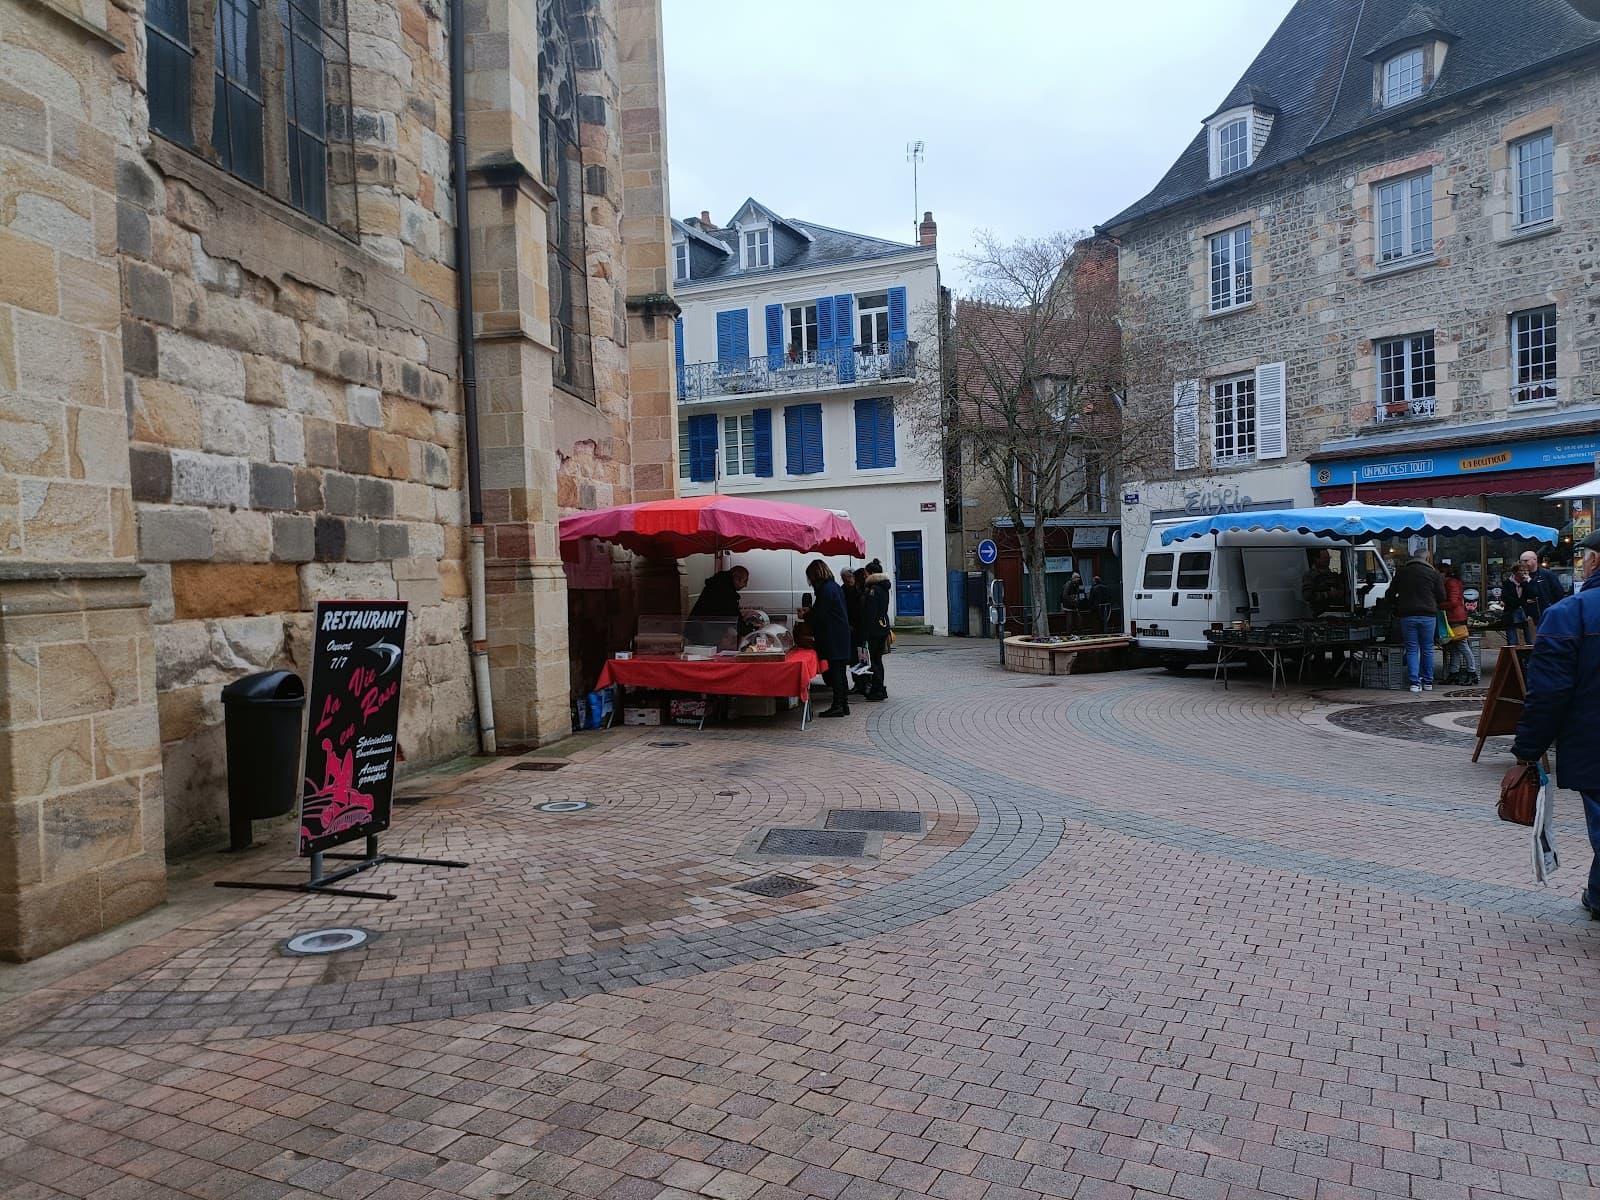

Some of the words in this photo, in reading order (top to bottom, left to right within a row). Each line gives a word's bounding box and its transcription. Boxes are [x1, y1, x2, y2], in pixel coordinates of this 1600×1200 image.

[1364, 467, 1373, 477] UN
[1373, 465, 1389, 476] PION
[1389, 463, 1409, 474] C'EST
[1410, 461, 1426, 472] TOUT
[1473, 453, 1507, 468] BOUTIQUE
[321, 610, 405, 631] RESTAURANT
[326, 639, 353, 652] Ouvert
[330, 655, 348, 670] 7/7
[315, 694, 341, 735] La
[348, 666, 376, 697] Vie
[339, 722, 355, 746] en
[360, 681, 397, 726] Rose
[358, 760, 390, 777] Accueil
[357, 772, 387, 789] groupes
